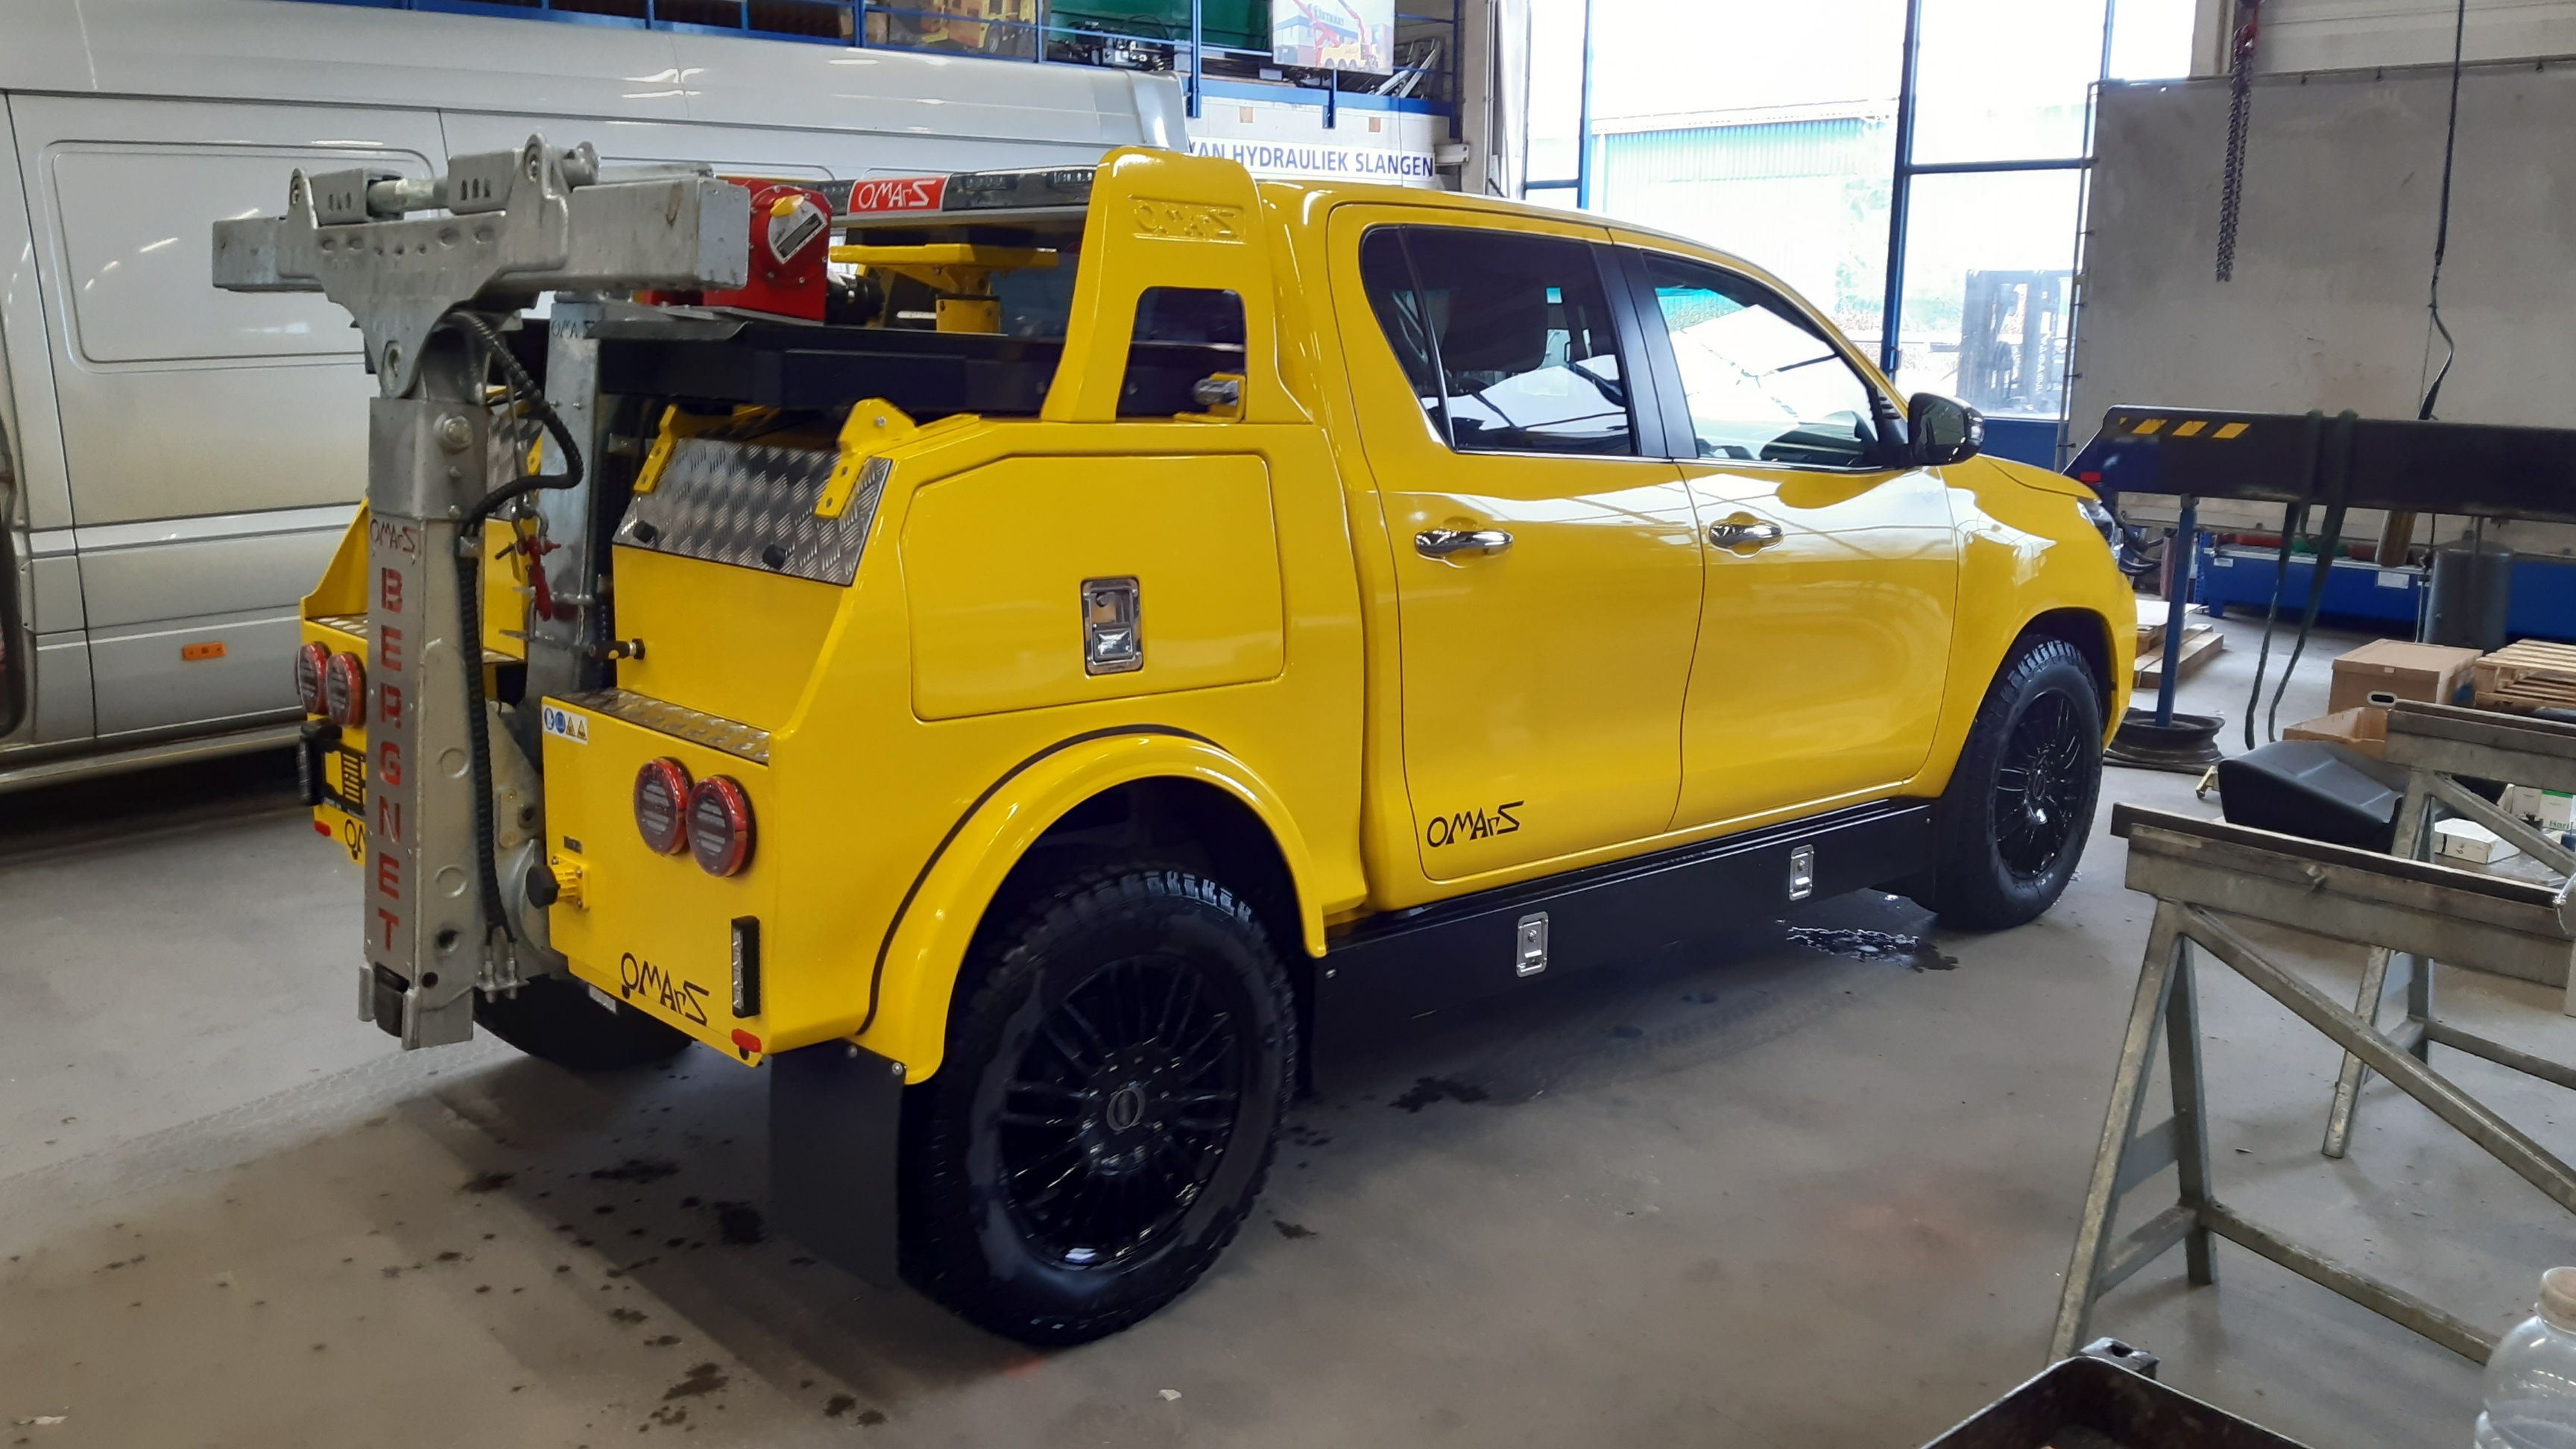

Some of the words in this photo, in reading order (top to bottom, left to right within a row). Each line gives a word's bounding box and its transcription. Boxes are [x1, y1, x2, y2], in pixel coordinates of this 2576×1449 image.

[1233, 145, 1348, 171] HYDRAULIEK
[1355, 153, 1433, 177] SLANGEN
[378, 567, 403, 951] BERGNET
